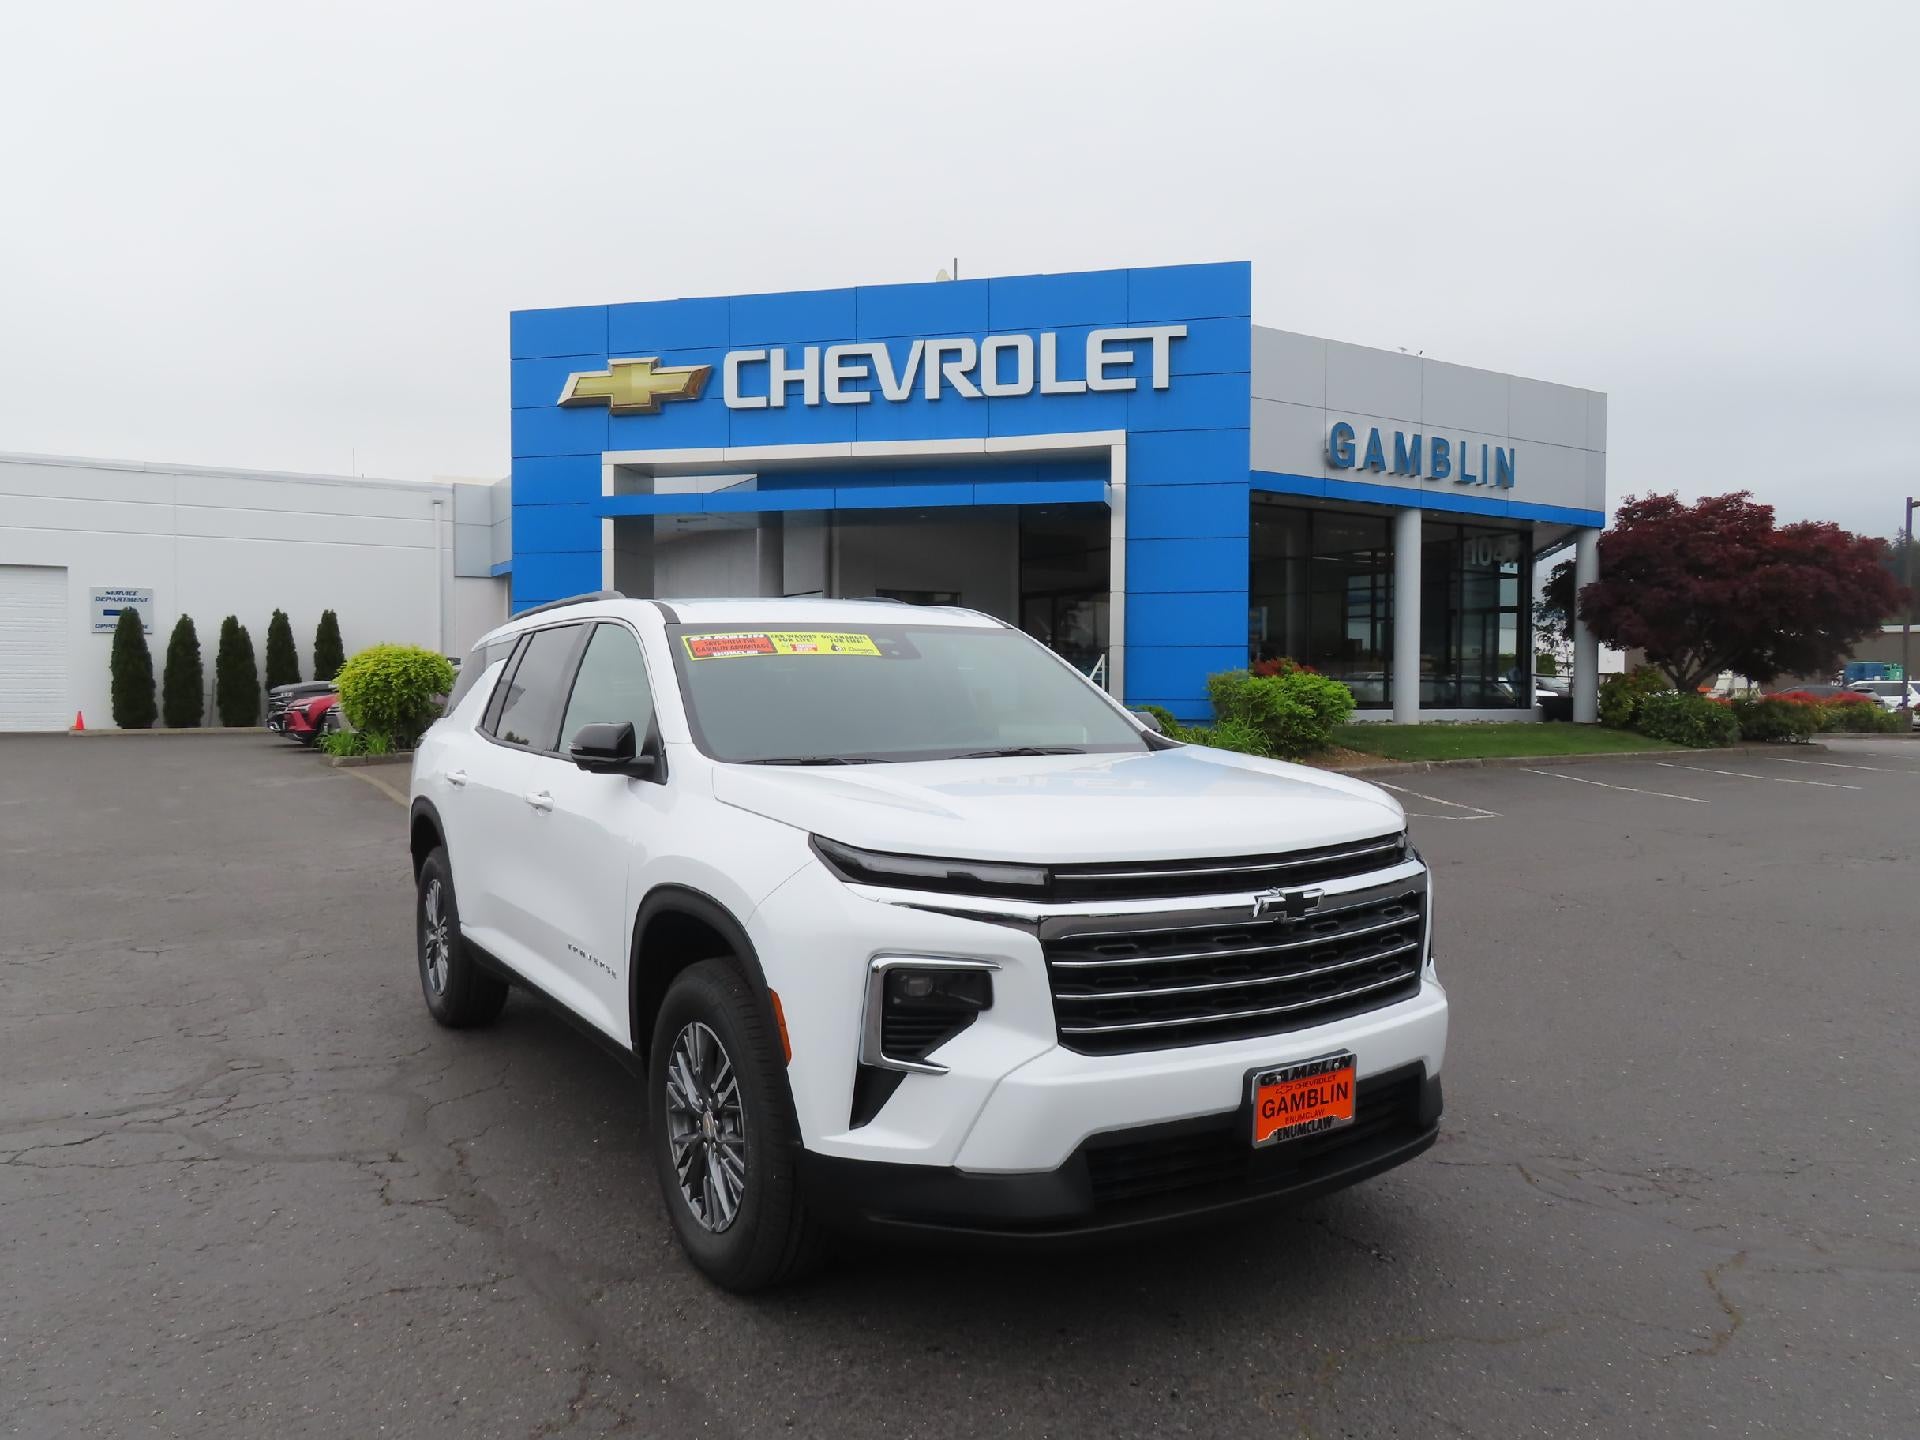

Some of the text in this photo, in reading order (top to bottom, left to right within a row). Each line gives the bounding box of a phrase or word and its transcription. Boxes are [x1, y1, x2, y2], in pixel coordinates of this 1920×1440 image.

[723, 325, 1187, 409] CHEVROLET
[1329, 421, 1515, 489] GAMBLIN
[1260, 1054, 1353, 1087] GAMBLIN
[1294, 1074, 1337, 1090] CHEVROLET
[1261, 1081, 1349, 1119] GAMBLIN
[1284, 1108, 1326, 1125] ENUMCLAW
[1276, 1115, 1333, 1141] ENUMCLAW
